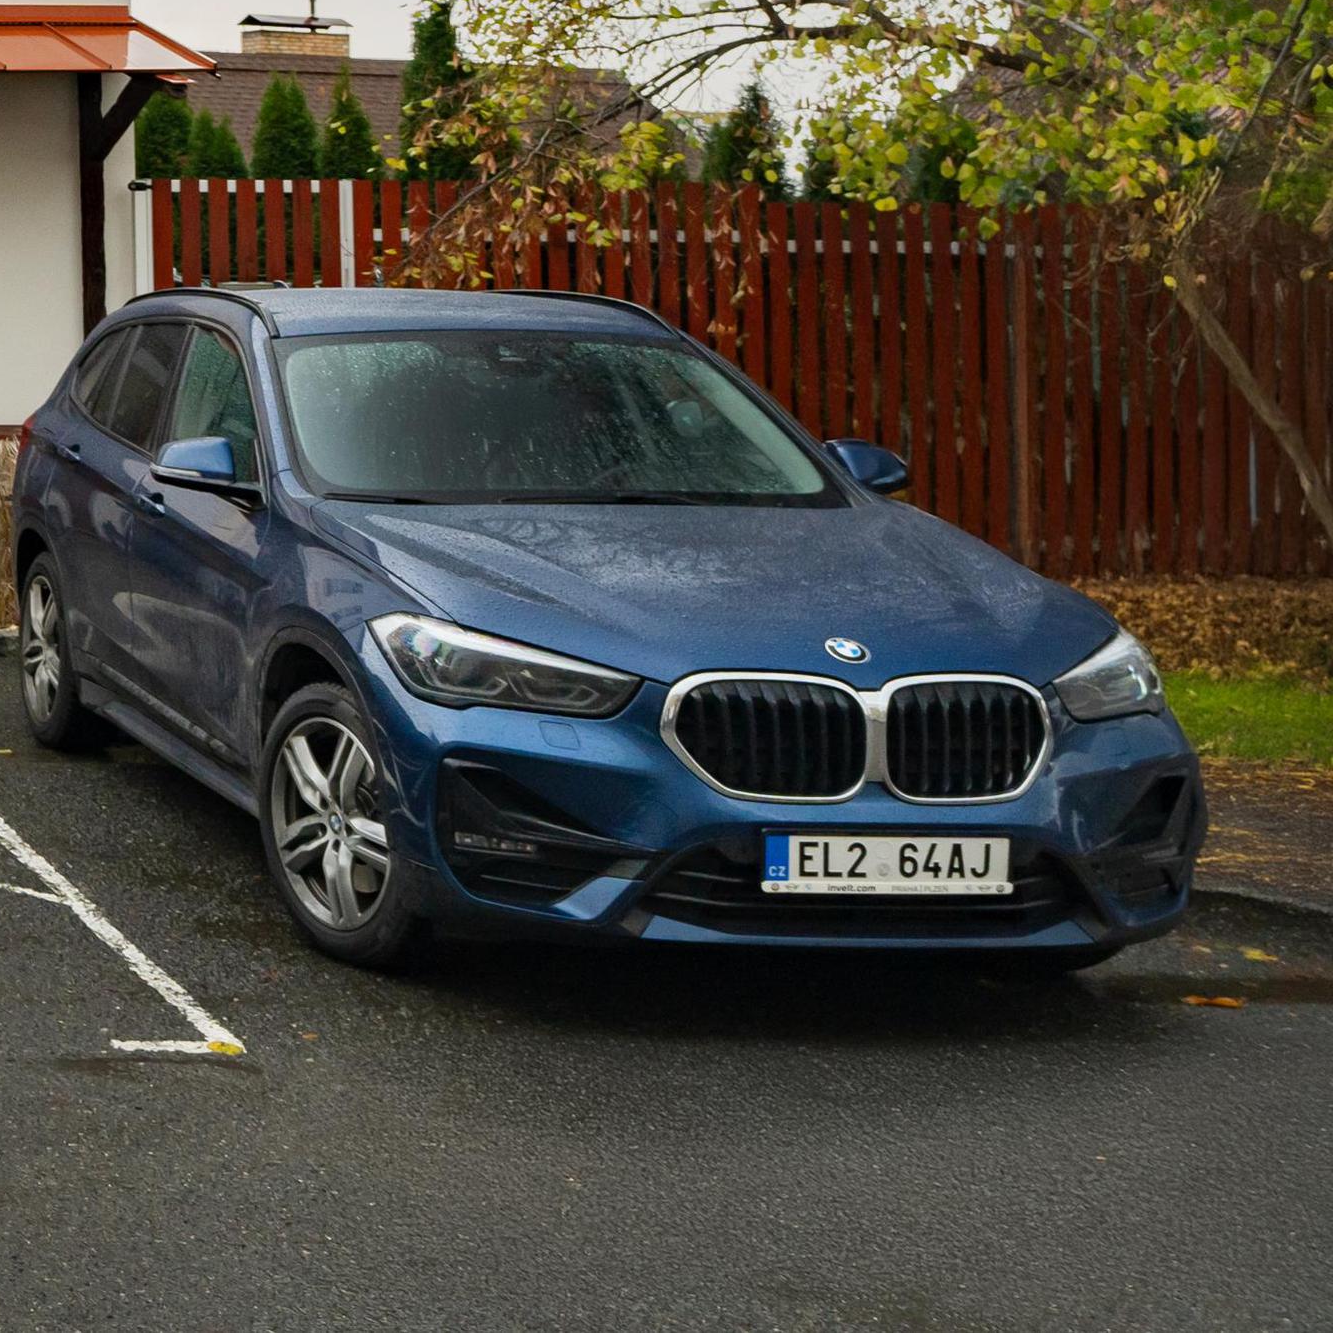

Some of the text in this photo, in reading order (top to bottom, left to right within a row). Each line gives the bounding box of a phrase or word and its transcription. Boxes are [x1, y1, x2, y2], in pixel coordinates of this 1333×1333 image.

[768, 865, 786, 877] CZ
[799, 841, 992, 879] EL2 64AJ
